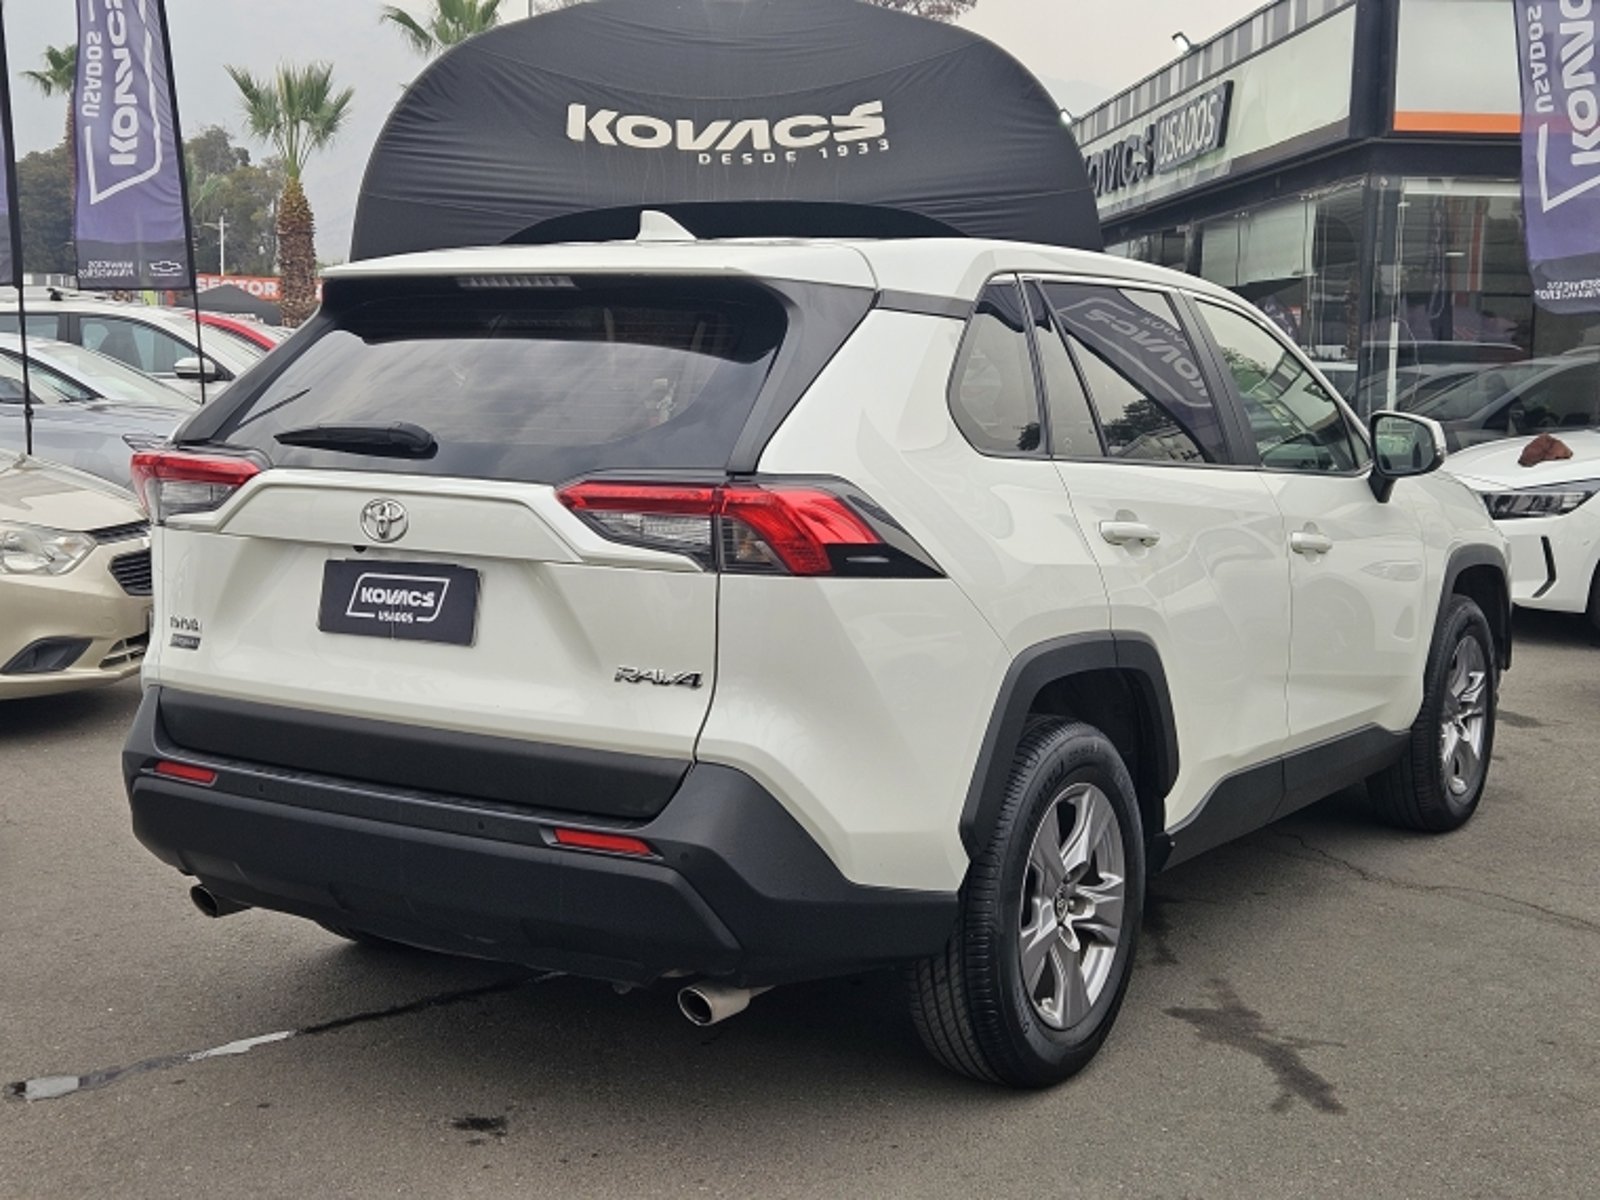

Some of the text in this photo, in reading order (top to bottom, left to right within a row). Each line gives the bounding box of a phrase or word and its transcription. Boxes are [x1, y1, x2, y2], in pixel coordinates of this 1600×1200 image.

[566, 100, 886, 151] KOVACS
[698, 138, 890, 166] DESDE 1933
[1086, 124, 1154, 199] OVACS
[361, 586, 435, 607] KOVACS
[614, 665, 703, 690] RAV4
